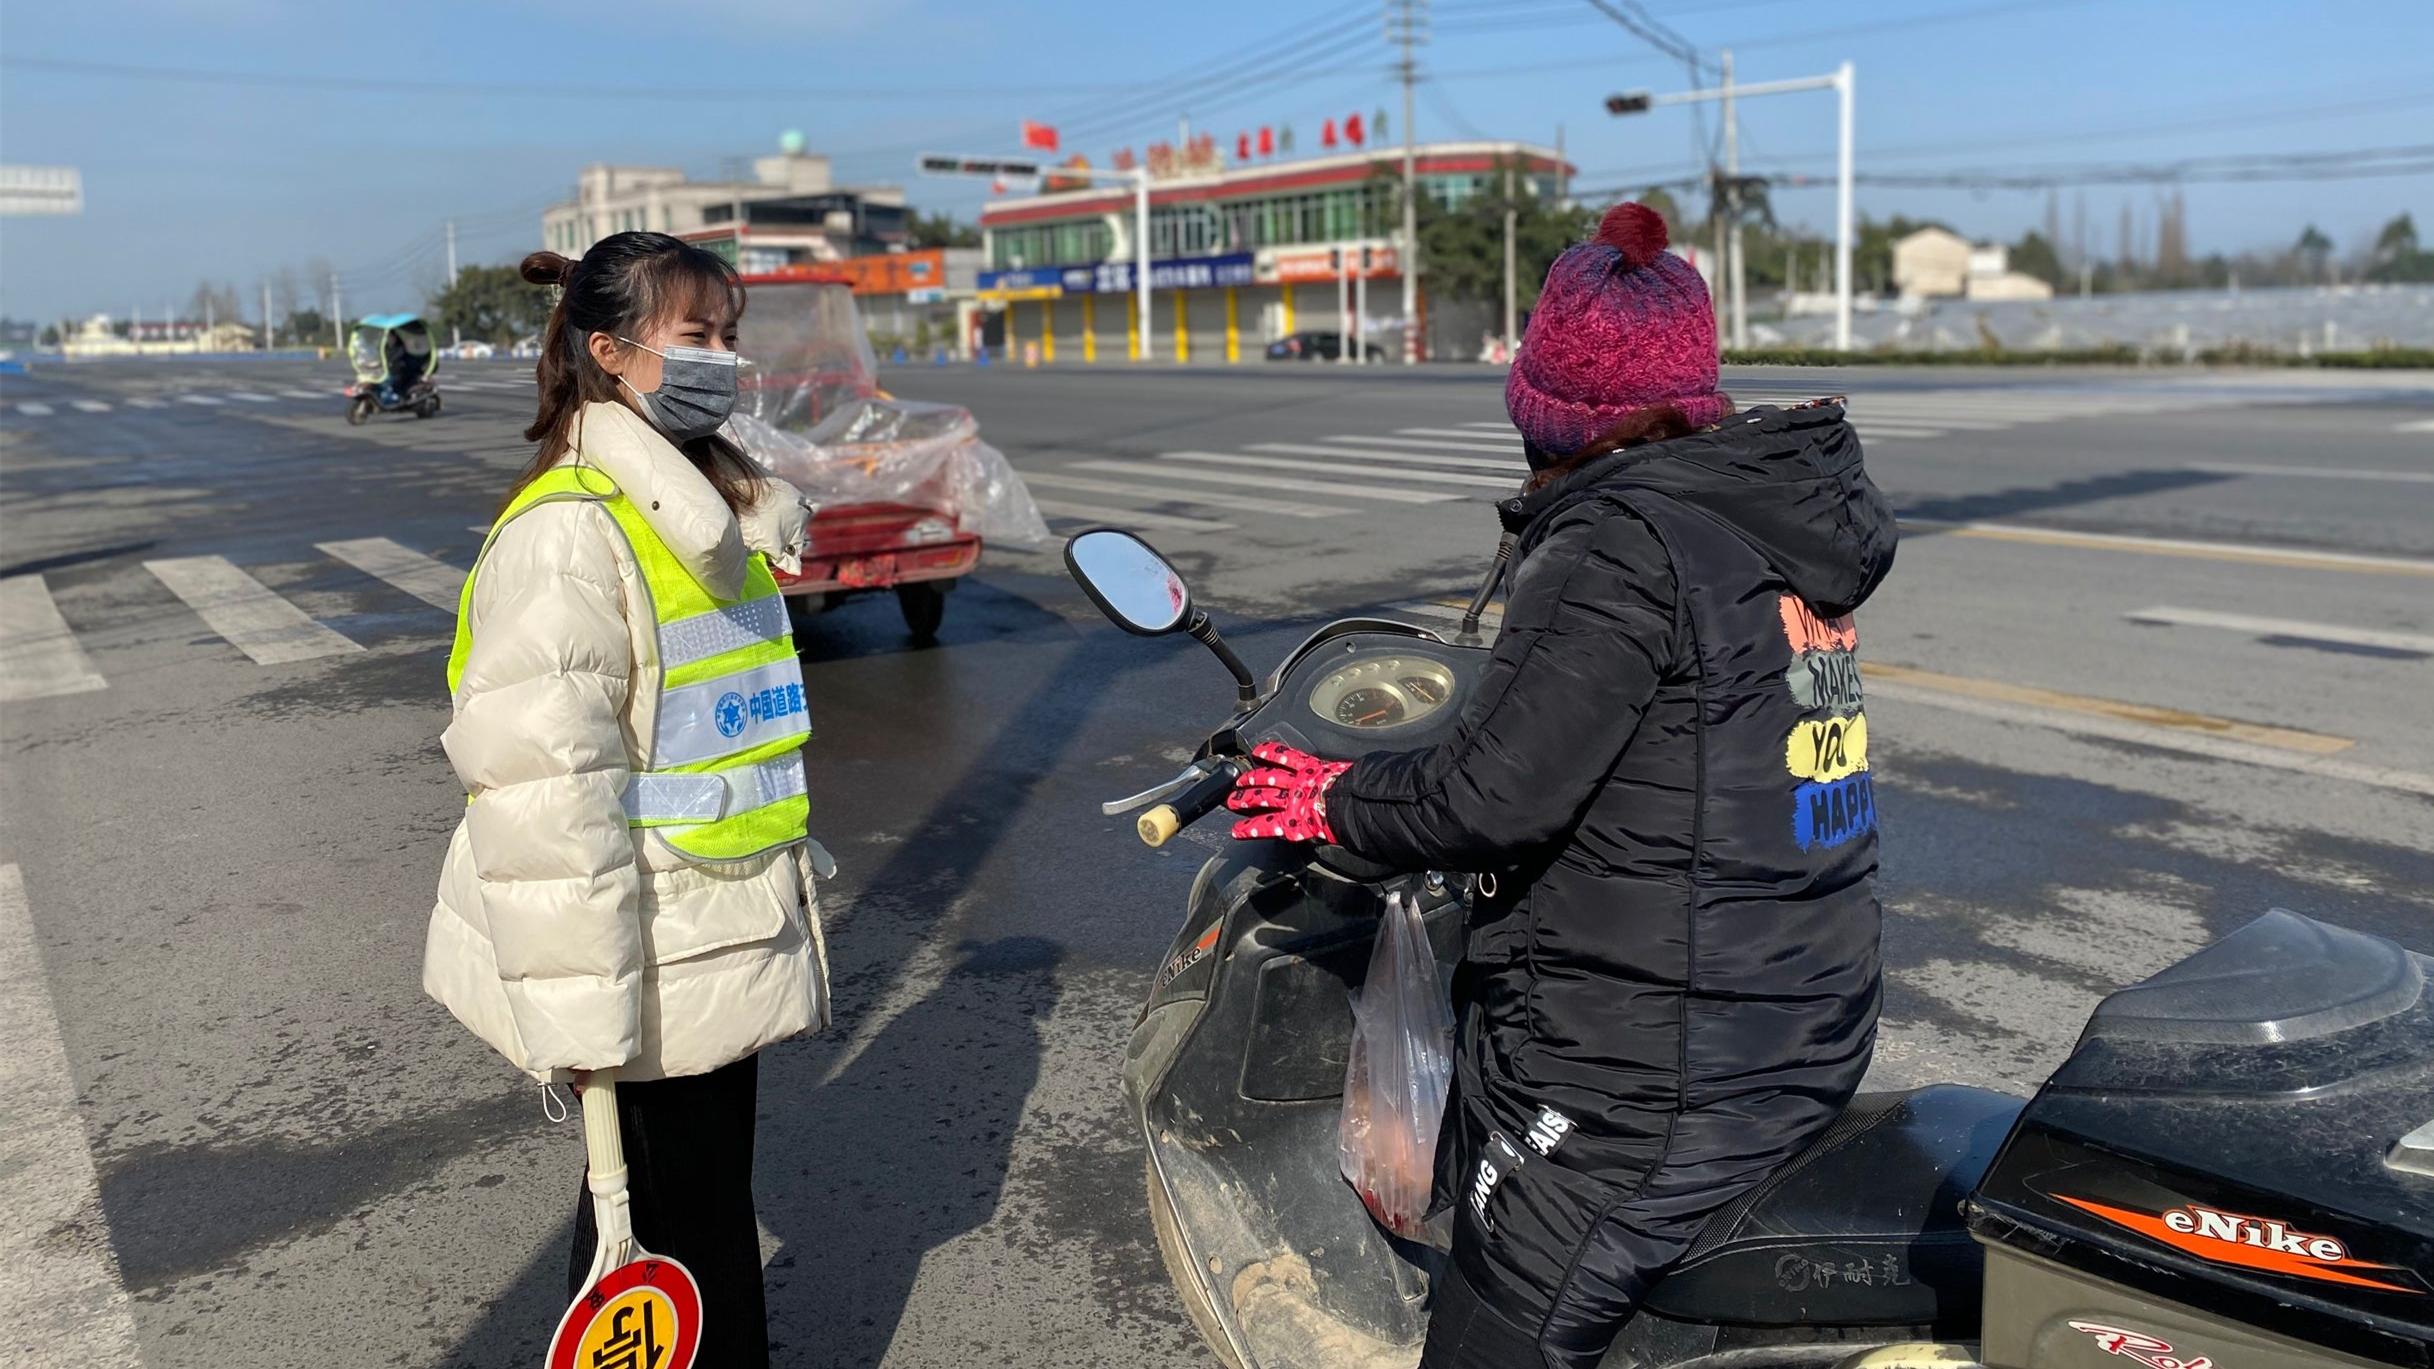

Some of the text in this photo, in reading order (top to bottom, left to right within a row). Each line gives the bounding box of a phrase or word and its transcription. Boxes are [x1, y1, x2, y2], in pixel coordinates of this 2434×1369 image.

[1161, 947, 1202, 988] eNike
[2164, 1208, 2345, 1262] eNike
[1812, 1253, 1912, 1290] 伊耐克
